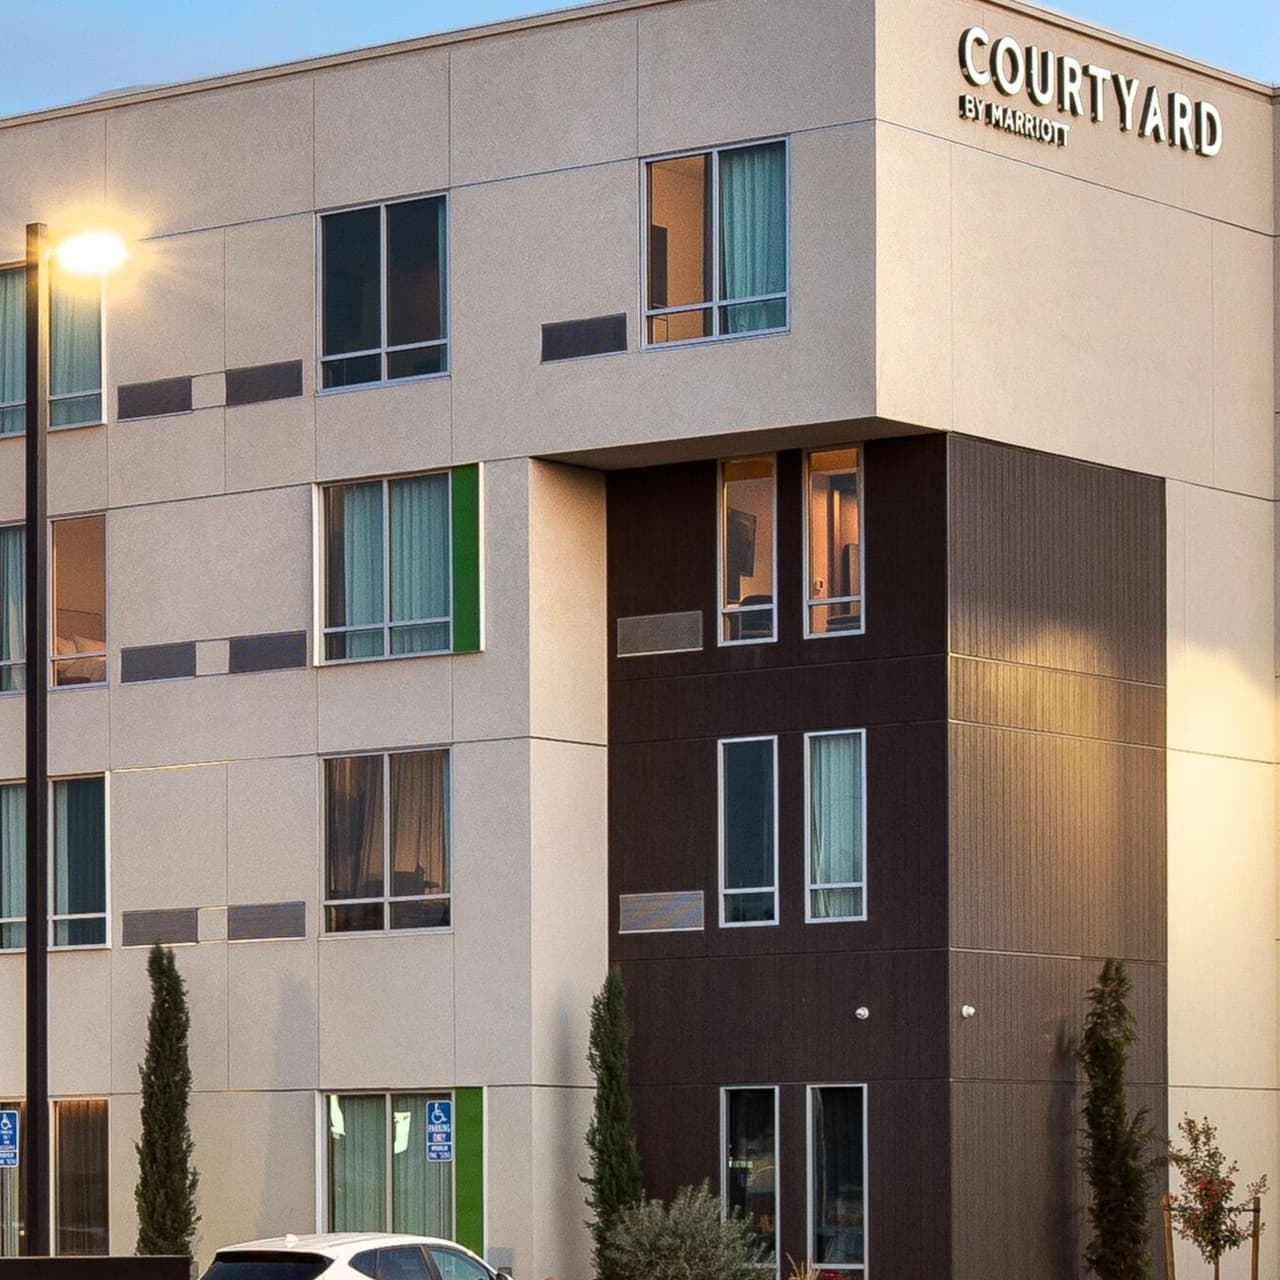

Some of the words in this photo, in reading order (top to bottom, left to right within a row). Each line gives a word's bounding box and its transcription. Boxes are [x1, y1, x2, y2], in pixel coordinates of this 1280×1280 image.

[958, 26, 1223, 157] COURTYARD
[959, 94, 986, 121] BY
[988, 103, 1072, 148] MARRIOTT
